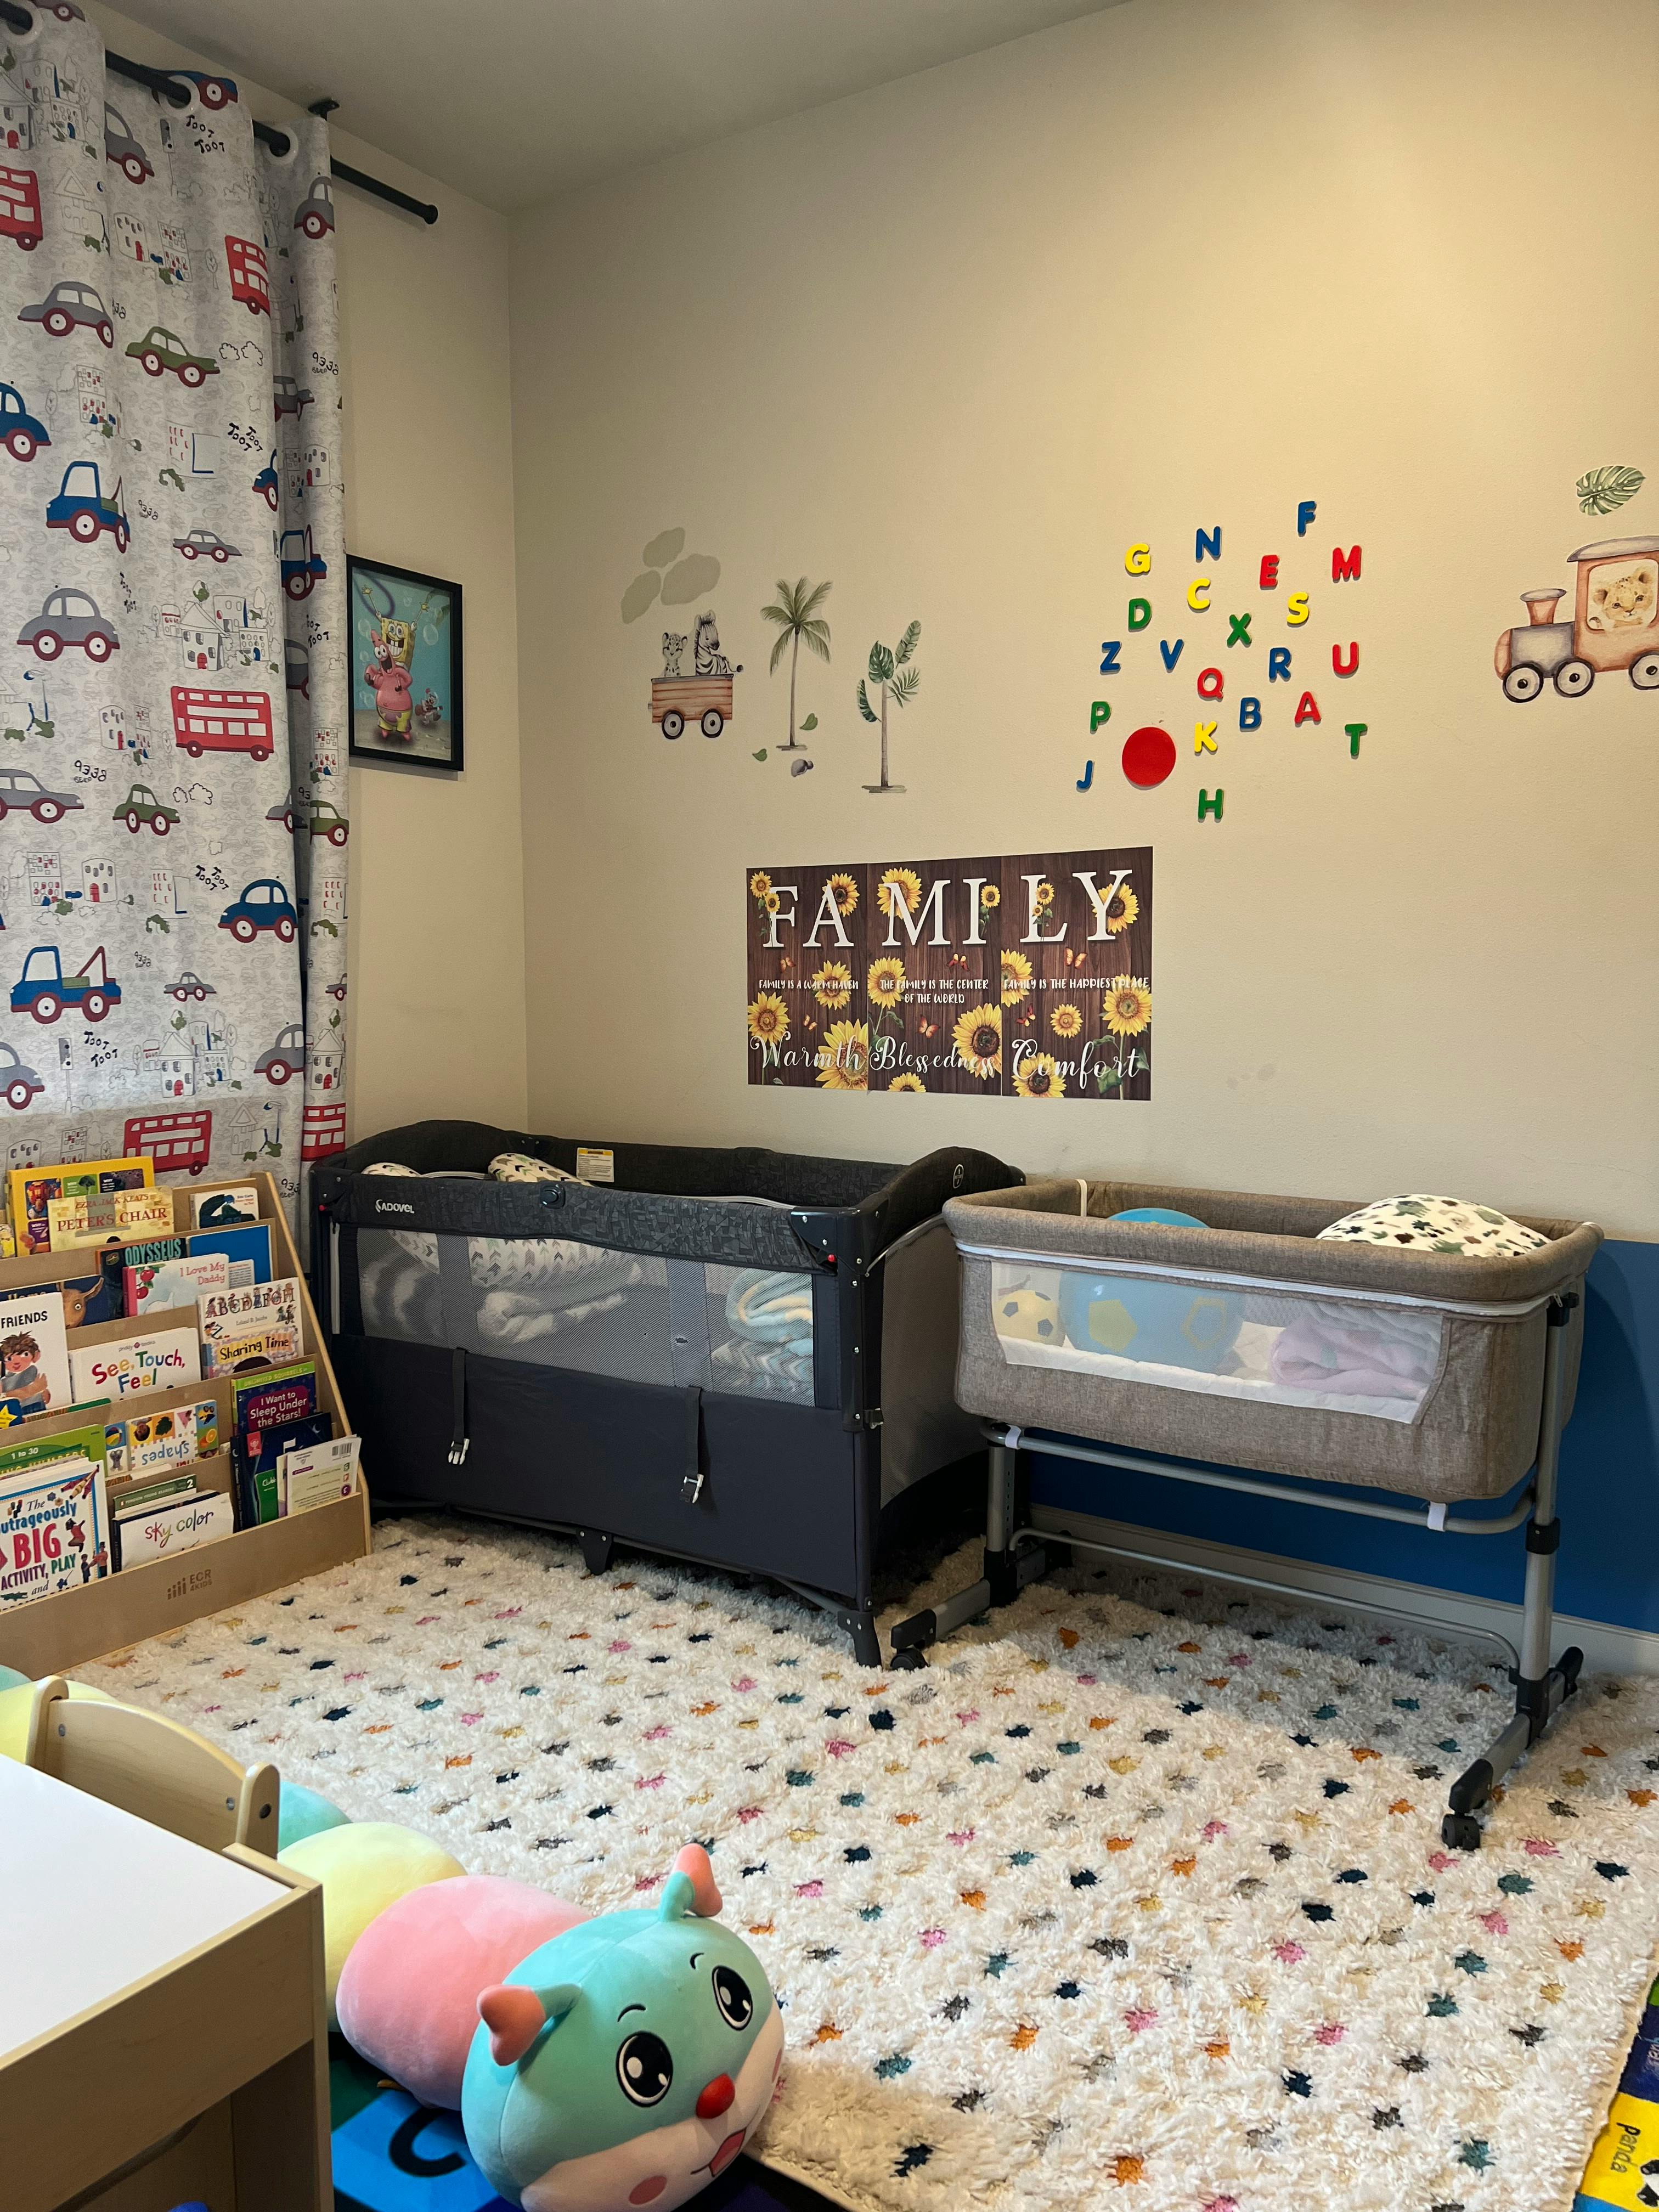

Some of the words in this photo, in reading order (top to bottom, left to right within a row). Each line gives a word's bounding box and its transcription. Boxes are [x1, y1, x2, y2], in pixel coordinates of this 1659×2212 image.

[186, 115, 215, 138] TOOT
[194, 139, 224, 154] TOOT
[228, 422, 252, 451] TOOT
[246, 426, 263, 452] TOOT
[1297, 500, 1317, 534] F
[1195, 526, 1221, 560] N
[1125, 544, 1151, 574] G
[1260, 555, 1280, 588] E
[1332, 545, 1362, 580] M
[1187, 578, 1211, 610] C
[1286, 592, 1310, 625] S
[1128, 598, 1152, 629] D
[1227, 613, 1251, 646] X
[1100, 641, 1121, 673] Z
[1160, 639, 1183, 671] V
[1269, 647, 1291, 680] R
[1332, 641, 1359, 675] U
[1197, 668, 1224, 699] Q
[1090, 701, 1111, 732] P
[1239, 697, 1261, 730] B
[1294, 691, 1321, 724] A
[1194, 721, 1217, 753] K
[1345, 723, 1368, 757] T
[1076, 760, 1094, 789] J
[1198, 789, 1224, 820] H
[195, 865, 218, 890] TOOT
[211, 867, 229, 889] TOOT
[759, 979, 785, 989] FAMILY
[788, 979, 793, 989] IS
[797, 980, 802, 989] A
[804, 980, 830, 989] WARM
[833, 980, 859, 989] HAVEN
[880, 979, 894, 989] THE
[896, 979, 926, 989] FAMILY
[929, 979, 936, 989] IS
[939, 979, 954, 989] THE
[957, 979, 989, 989] CENTER
[1004, 978, 1036, 989] FAMILY
[1039, 978, 1047, 989] IS
[1050, 978, 1066, 989] THE
[1069, 977, 1116, 989] HAPPIEST
[1119, 977, 1149, 989] PLACE
[905, 994, 914, 1003] OF
[917, 994, 931, 1003] THE
[934, 993, 964, 1003] WORLD
[83, 1031, 109, 1049] TOOT
[750, 1031, 867, 1070] Warmth
[91, 1048, 118, 1067] TOOT
[870, 1036, 995, 1078] Blessedness
[1011, 1039, 1140, 1090] Comfort
[75, 1201, 97, 1210] EZRA
[99, 1197, 121, 1207] JACK
[122, 1194, 149, 1203] KEATS
[58, 1213, 114, 1232] PETER'S
[119, 1207, 167, 1224] CHAIR
[125, 1238, 182, 1266] ODYSSEUS
[187, 1266, 207, 1276] Love
[210, 1262, 225, 1272] My
[198, 1274, 225, 1285] Daddy
[1, 1311, 48, 1329] FRIENDS
[220, 1341, 262, 1360] Sharing
[265, 1336, 289, 1348] Time
[92, 1359, 134, 1385] See,
[135, 1348, 185, 1368] Touch,
[117, 1368, 157, 1393] Feel
[250, 1407, 276, 1419] Sleep
[279, 1398, 307, 1411] Under
[261, 1398, 264, 1406] I
[266, 1393, 286, 1404] Want
[257, 1417, 273, 1428] the
[276, 1408, 301, 1423] Stars!
[28, 1447, 39, 1455] 30
[187, 1479, 194, 1488] 2
[0, 1500, 77, 1533] utrageously
[27, 1499, 45, 1511] The
[176, 1509, 214, 1531] color
[13, 1522, 61, 1570] BIG
[1, 1563, 48, 1590] ACTIVITY,
[51, 1553, 76, 1574] PLAY
[189, 1569, 211, 1584] ECR
[31, 1580, 49, 1595] and
[1610, 2122, 1641, 2173] panda
